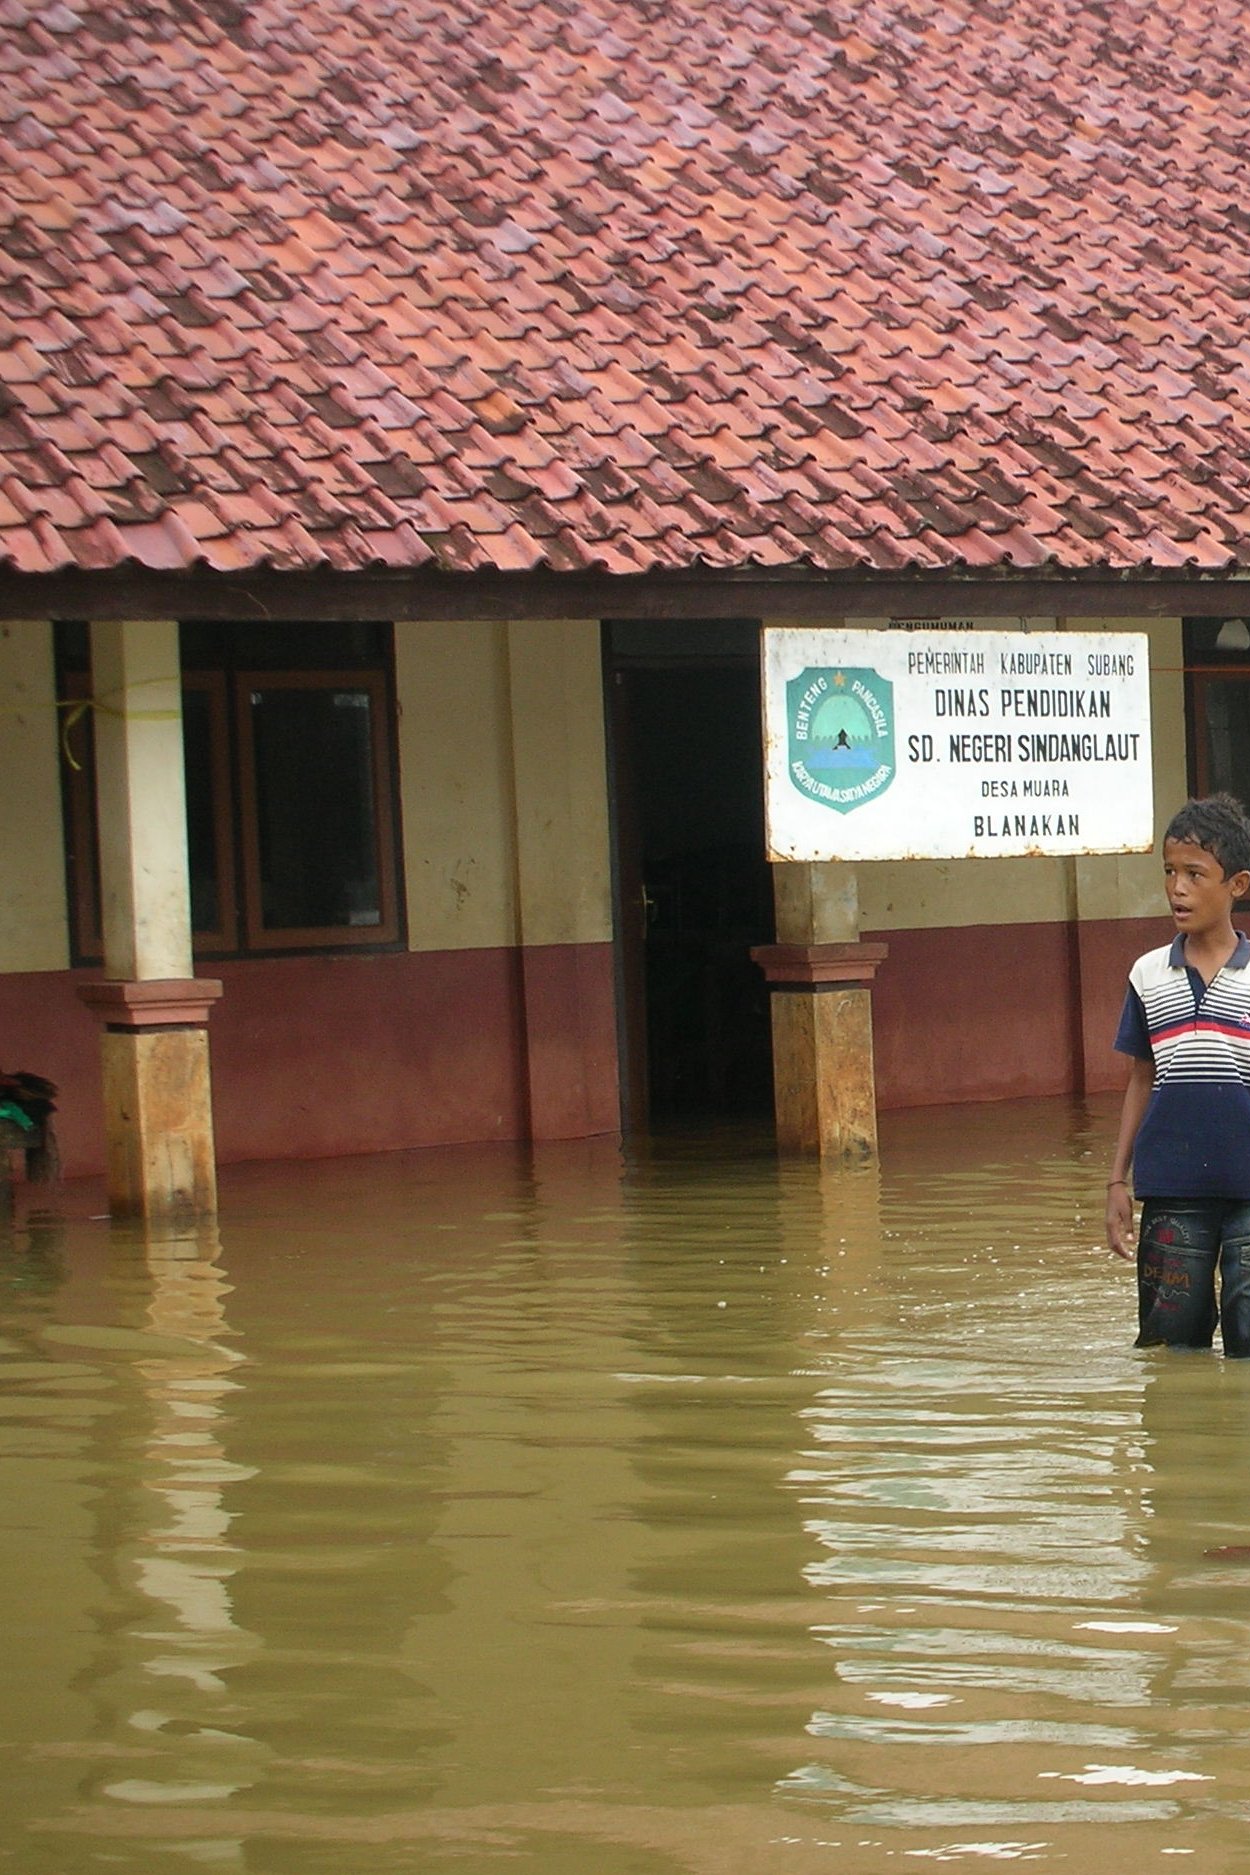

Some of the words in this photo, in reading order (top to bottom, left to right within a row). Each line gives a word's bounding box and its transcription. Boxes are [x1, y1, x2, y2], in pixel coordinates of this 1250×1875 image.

[908, 652, 985, 674] PEMERINTAH
[1001, 653, 1072, 675] KABUPATEN
[1088, 654, 1135, 676] SUBANG
[796, 677, 828, 740] BENTENG
[851, 680, 888, 738] PANCASILA
[935, 689, 990, 717] DINAS
[1001, 689, 1111, 718] PENDIDIKAN
[908, 734, 941, 762] SD.
[950, 734, 1012, 762] NEGERI
[1018, 734, 1140, 762] SINDANGLAUT
[981, 780, 1018, 797] DESA
[1023, 780, 1069, 797] MUARA
[974, 814, 1080, 837] BLANAKAN
